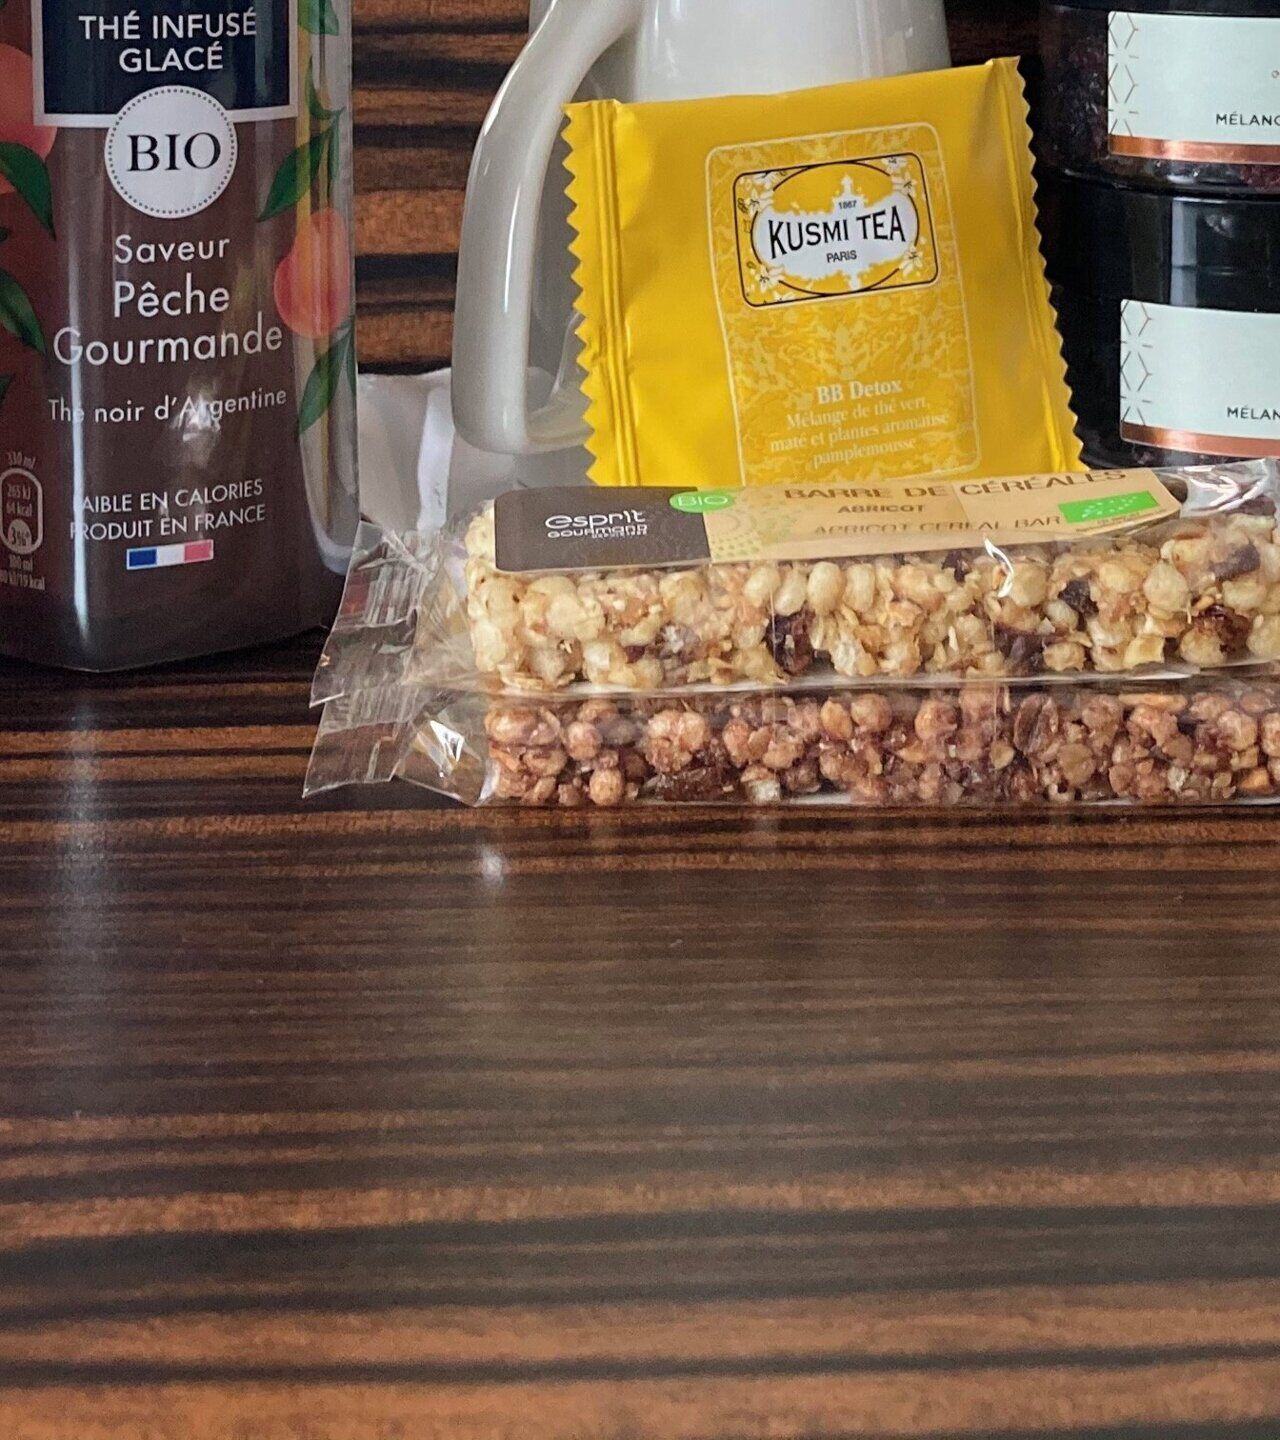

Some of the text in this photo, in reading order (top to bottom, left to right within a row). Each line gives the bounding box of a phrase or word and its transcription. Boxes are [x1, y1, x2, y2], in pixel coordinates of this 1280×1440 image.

[78, 6, 258, 41] THÉ INFUSÉ
[118, 41, 224, 73] GLACÉ
[126, 131, 222, 173] BIO
[838, 200, 858, 210] 1867
[768, 205, 907, 260] KUSMI TEA
[114, 233, 232, 264] Saveur
[826, 250, 858, 263] PARIS
[112, 272, 232, 318] Pêche
[53, 311, 284, 366] Gourmande
[816, 379, 903, 405] BB Detox
[94, 400, 145, 423] noir
[787, 409, 849, 430] Mélange
[852, 403, 870, 418] de
[874, 399, 896, 415] thé
[770, 409, 950, 453] maté et plantes aromatisé
[812, 437, 918, 470] pamplemousse
[74, 478, 264, 514] AIBLE EN CALORIES
[784, 469, 1126, 499] BARRE DE CÉRÉALES
[677, 493, 729, 508] BIO
[838, 503, 926, 514] ABRICOT
[160, 515, 188, 536] EN
[194, 503, 266, 531] FRANCE
[544, 509, 647, 530] esprit
